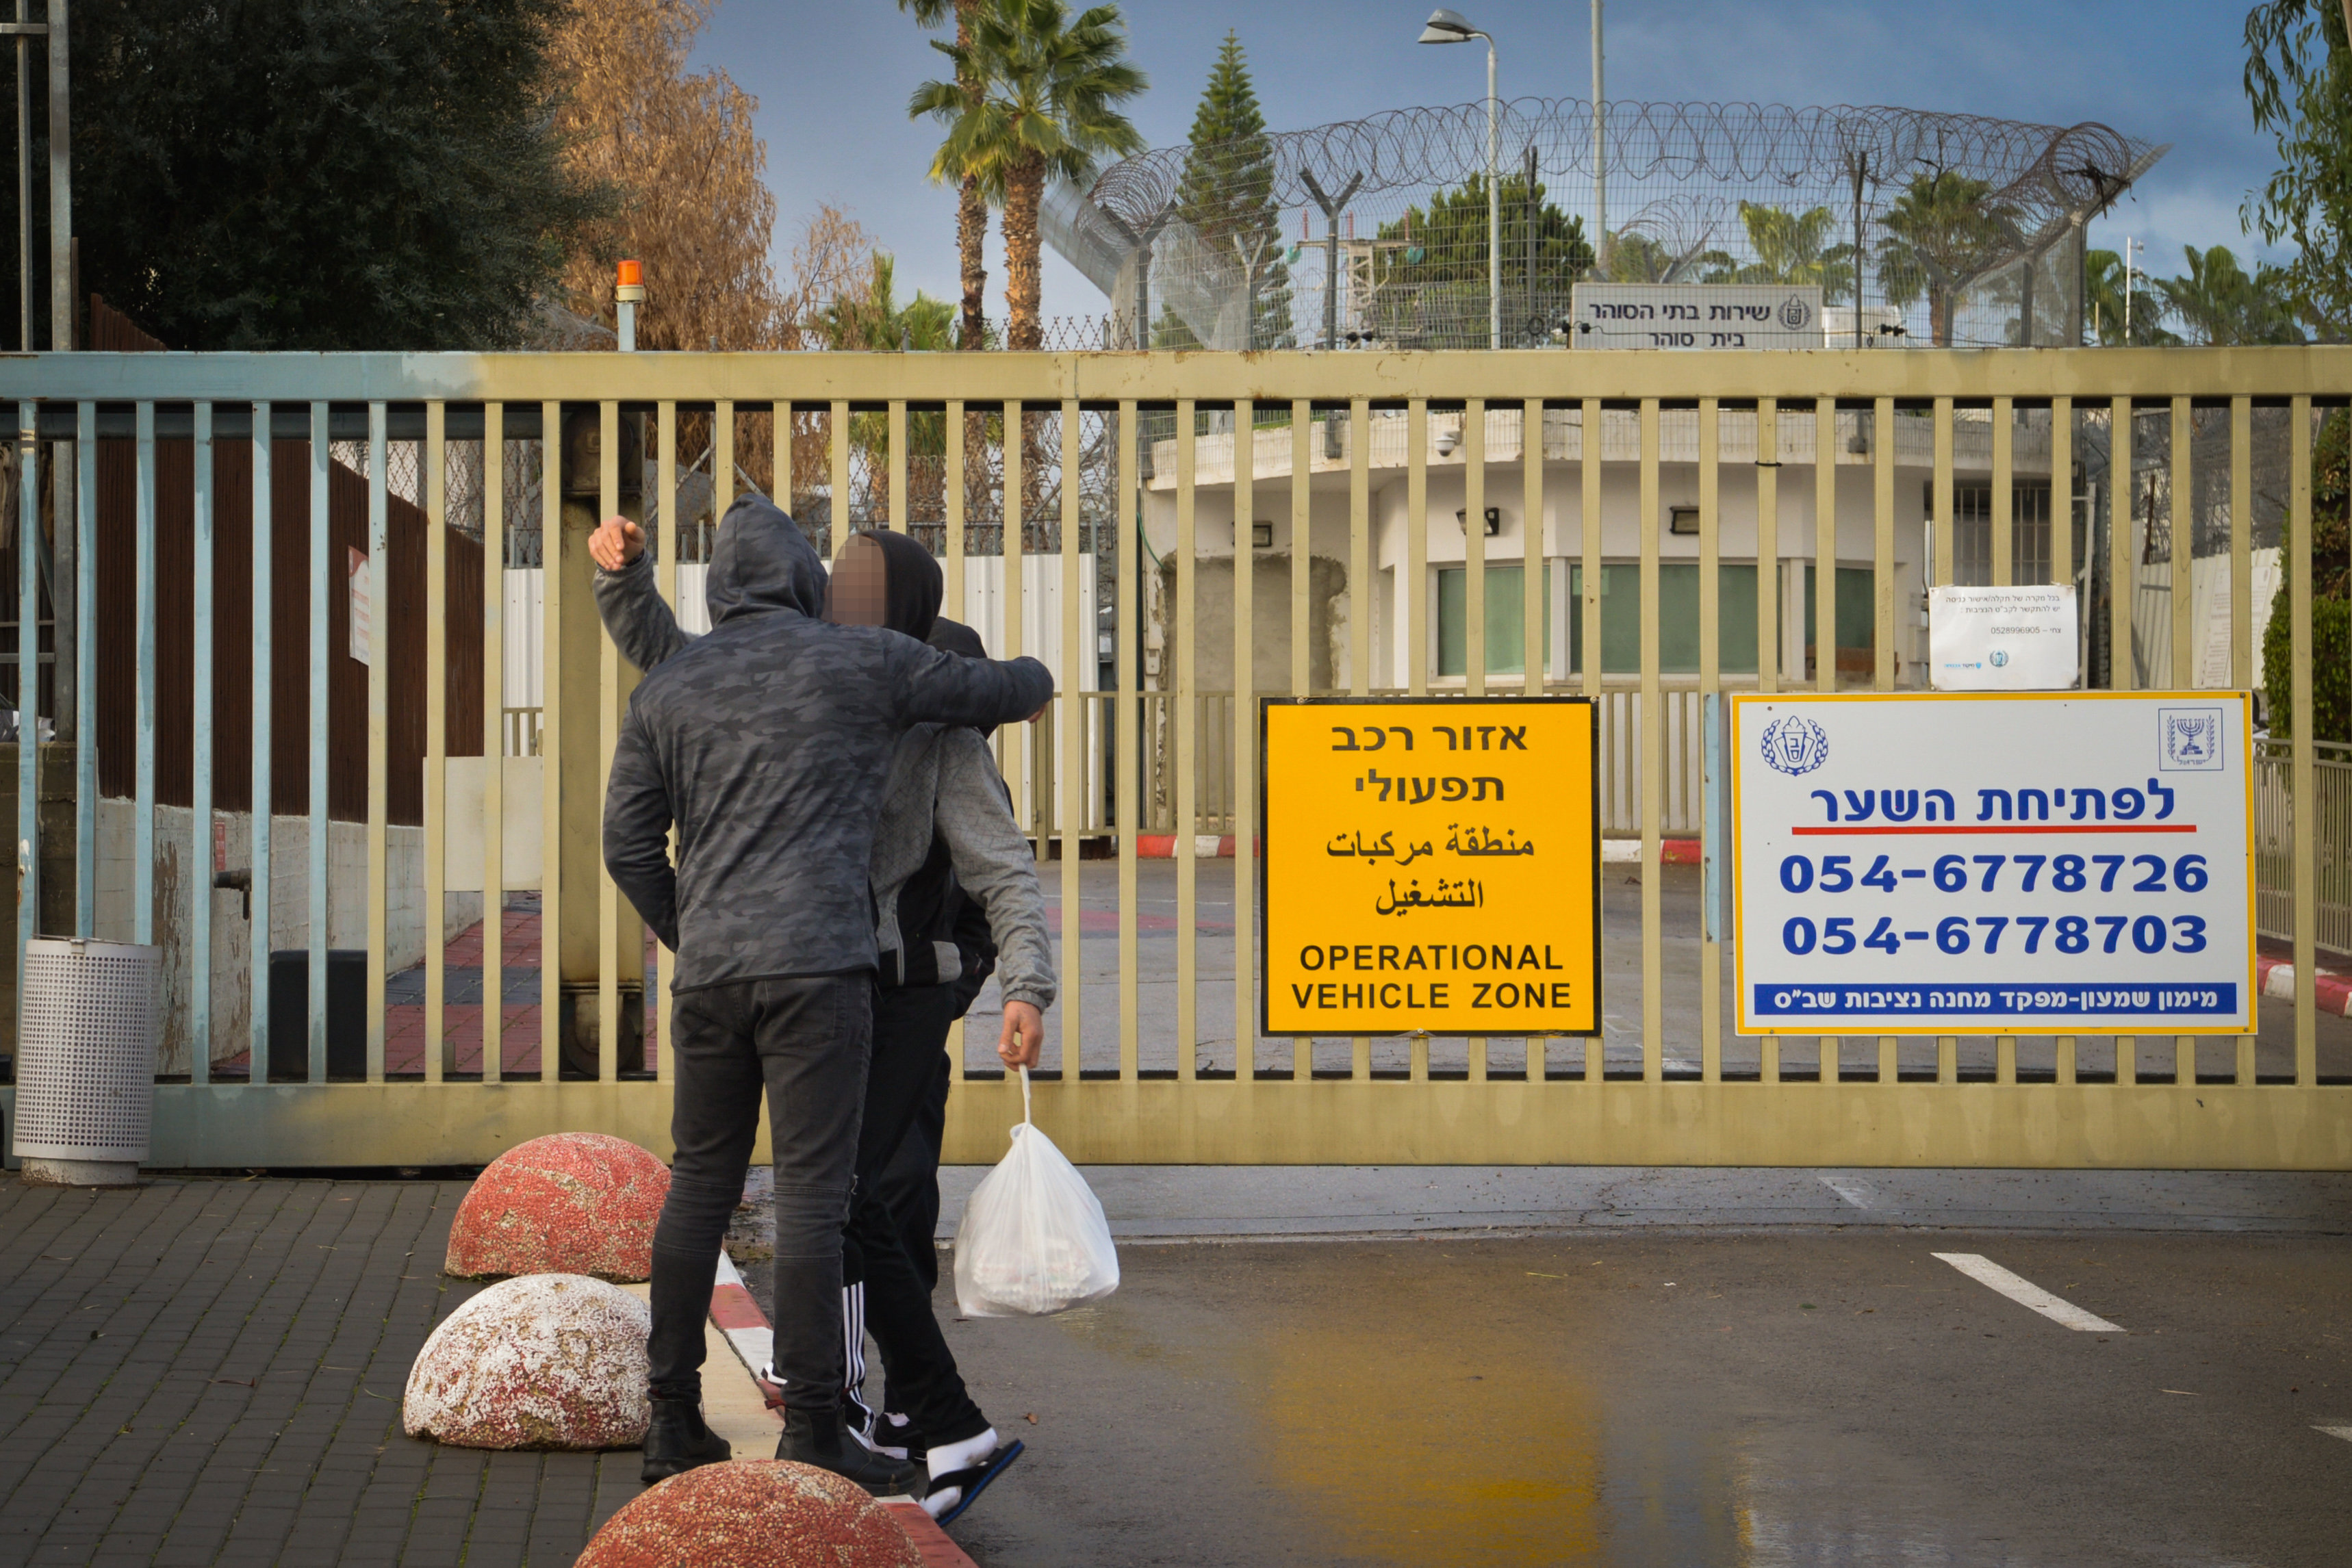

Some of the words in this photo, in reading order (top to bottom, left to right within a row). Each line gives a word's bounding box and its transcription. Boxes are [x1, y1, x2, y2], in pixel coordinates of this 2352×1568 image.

[1589, 303, 1654, 320] הסוהר
[1663, 305, 1700, 320] בתי
[1709, 304, 1771, 321] שירות
[1648, 333, 1695, 347] סוהר
[1711, 333, 1745, 347] בית
[2021, 604, 2051, 613] להתקשר
[1991, 626, 2041, 634] 0528996905
[1331, 726, 1414, 751] רכב
[1433, 725, 1528, 751] אזור
[1355, 769, 1504, 805] תפעולי
[1811, 788, 1956, 822] השער
[1978, 777, 2175, 821] לפתיחת
[1327, 830, 1433, 866] مركبات
[1445, 823, 1534, 856] منطقة
[1780, 853, 2210, 894] 054-6778726
[1375, 878, 1484, 917] التشغيل
[1782, 914, 2208, 955] 054-6778703
[1300, 944, 1563, 971] OPERATIONAL
[1291, 983, 1449, 1009] VEHICLE
[1471, 982, 1571, 1009] ZONE
[1774, 989, 1837, 1009] שב"ס
[1844, 992, 1921, 1008] נציבות
[1930, 992, 1991, 1008] מחנה
[1999, 991, 2150, 1010] שמעון-מפקד
[2158, 991, 2217, 1010] מימון
